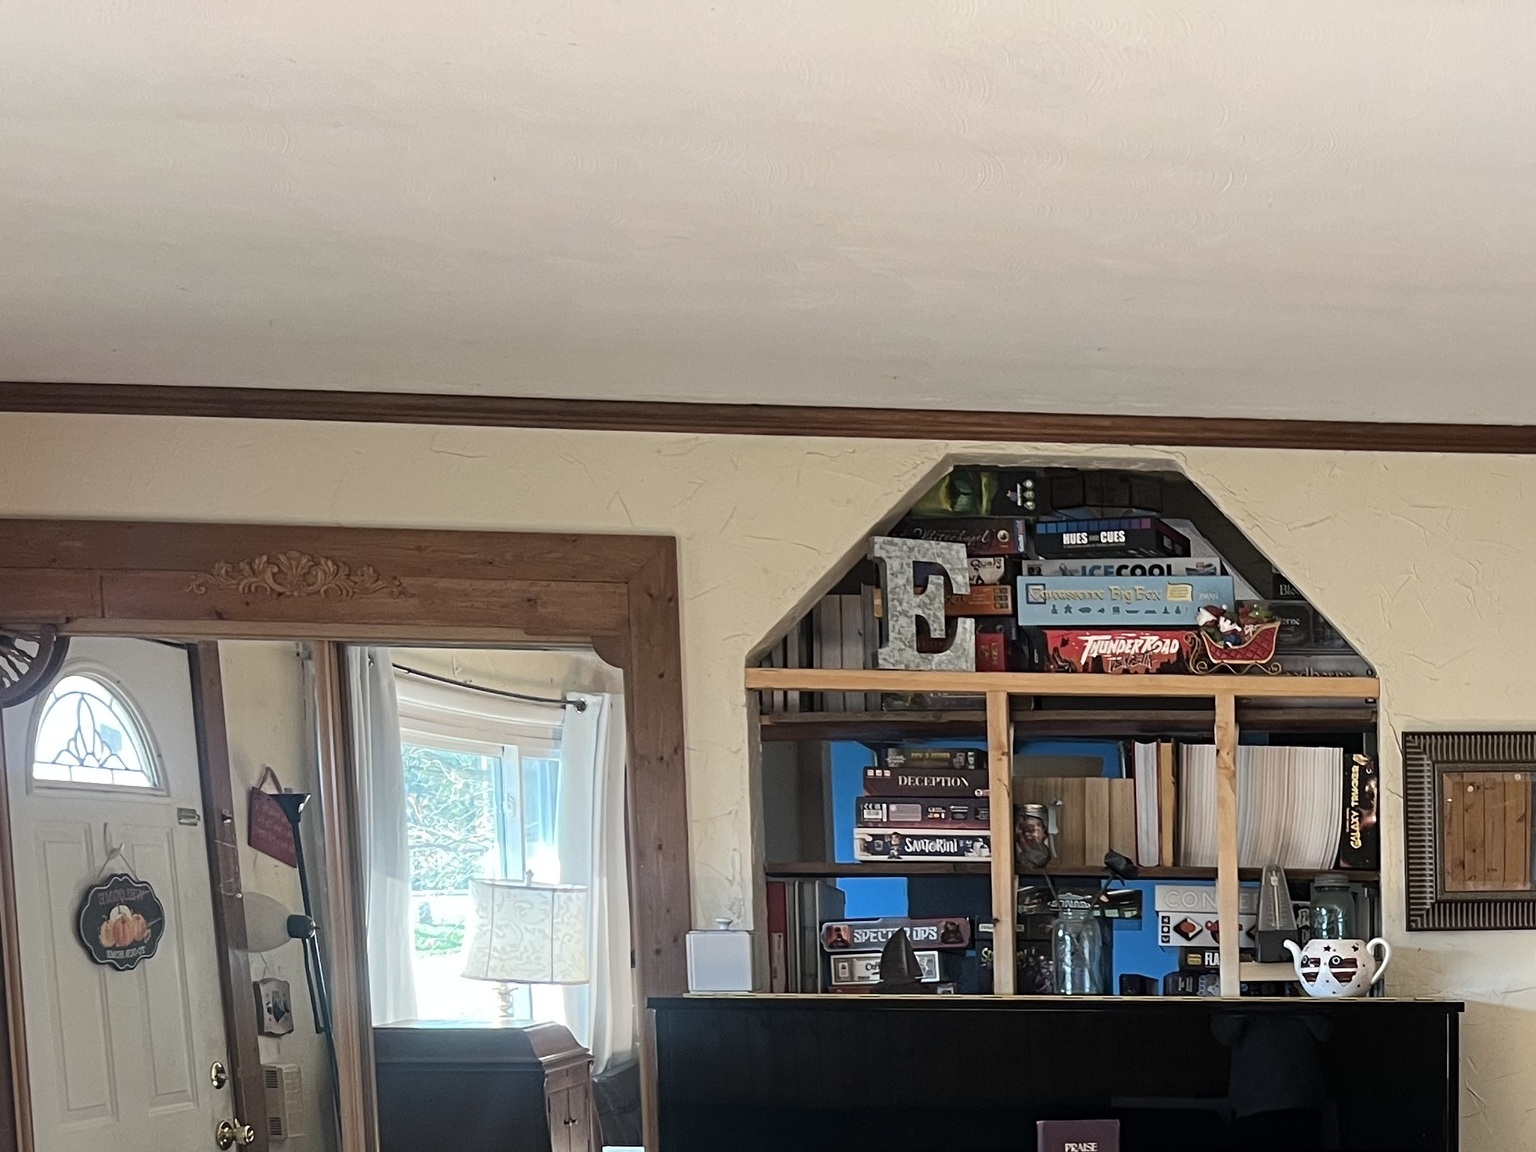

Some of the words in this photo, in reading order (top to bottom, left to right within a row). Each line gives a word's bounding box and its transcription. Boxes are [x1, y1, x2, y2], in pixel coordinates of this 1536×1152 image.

[1062, 533, 1088, 545] HUES
[1100, 530, 1126, 543] CUES
[870, 535, 977, 672] E
[1108, 585, 1132, 605] Big
[1135, 585, 1161, 602] Box
[1078, 635, 1144, 666] THUNDER
[1140, 635, 1180, 655] ROAD
[898, 775, 969, 787] DECEPTION
[1351, 765, 1360, 808] TRUCKER
[1350, 809, 1362, 849] GALAXY
[853, 927, 911, 943] SPECTR
[912, 926, 938, 941] OPS
